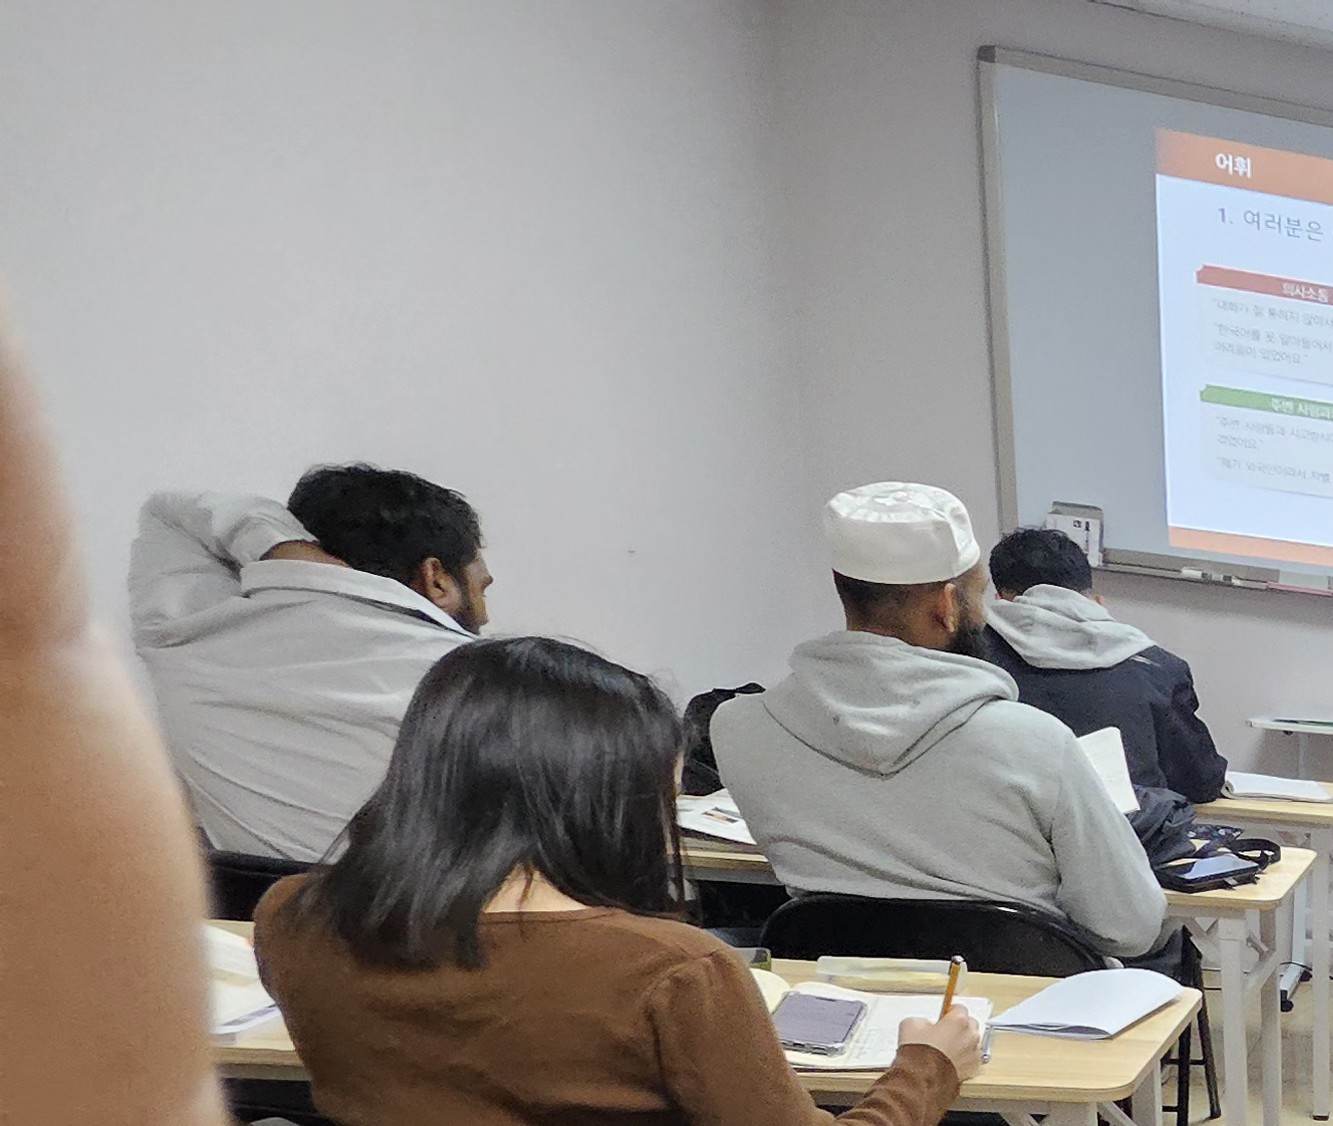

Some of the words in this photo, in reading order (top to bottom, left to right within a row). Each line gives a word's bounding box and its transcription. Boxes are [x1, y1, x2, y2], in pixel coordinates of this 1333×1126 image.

[1215, 151, 1251, 179] 어휘
[1218, 206, 1232, 224] 1.
[1243, 207, 1323, 242] 여러분은
[1282, 281, 1328, 302] 의사소통
